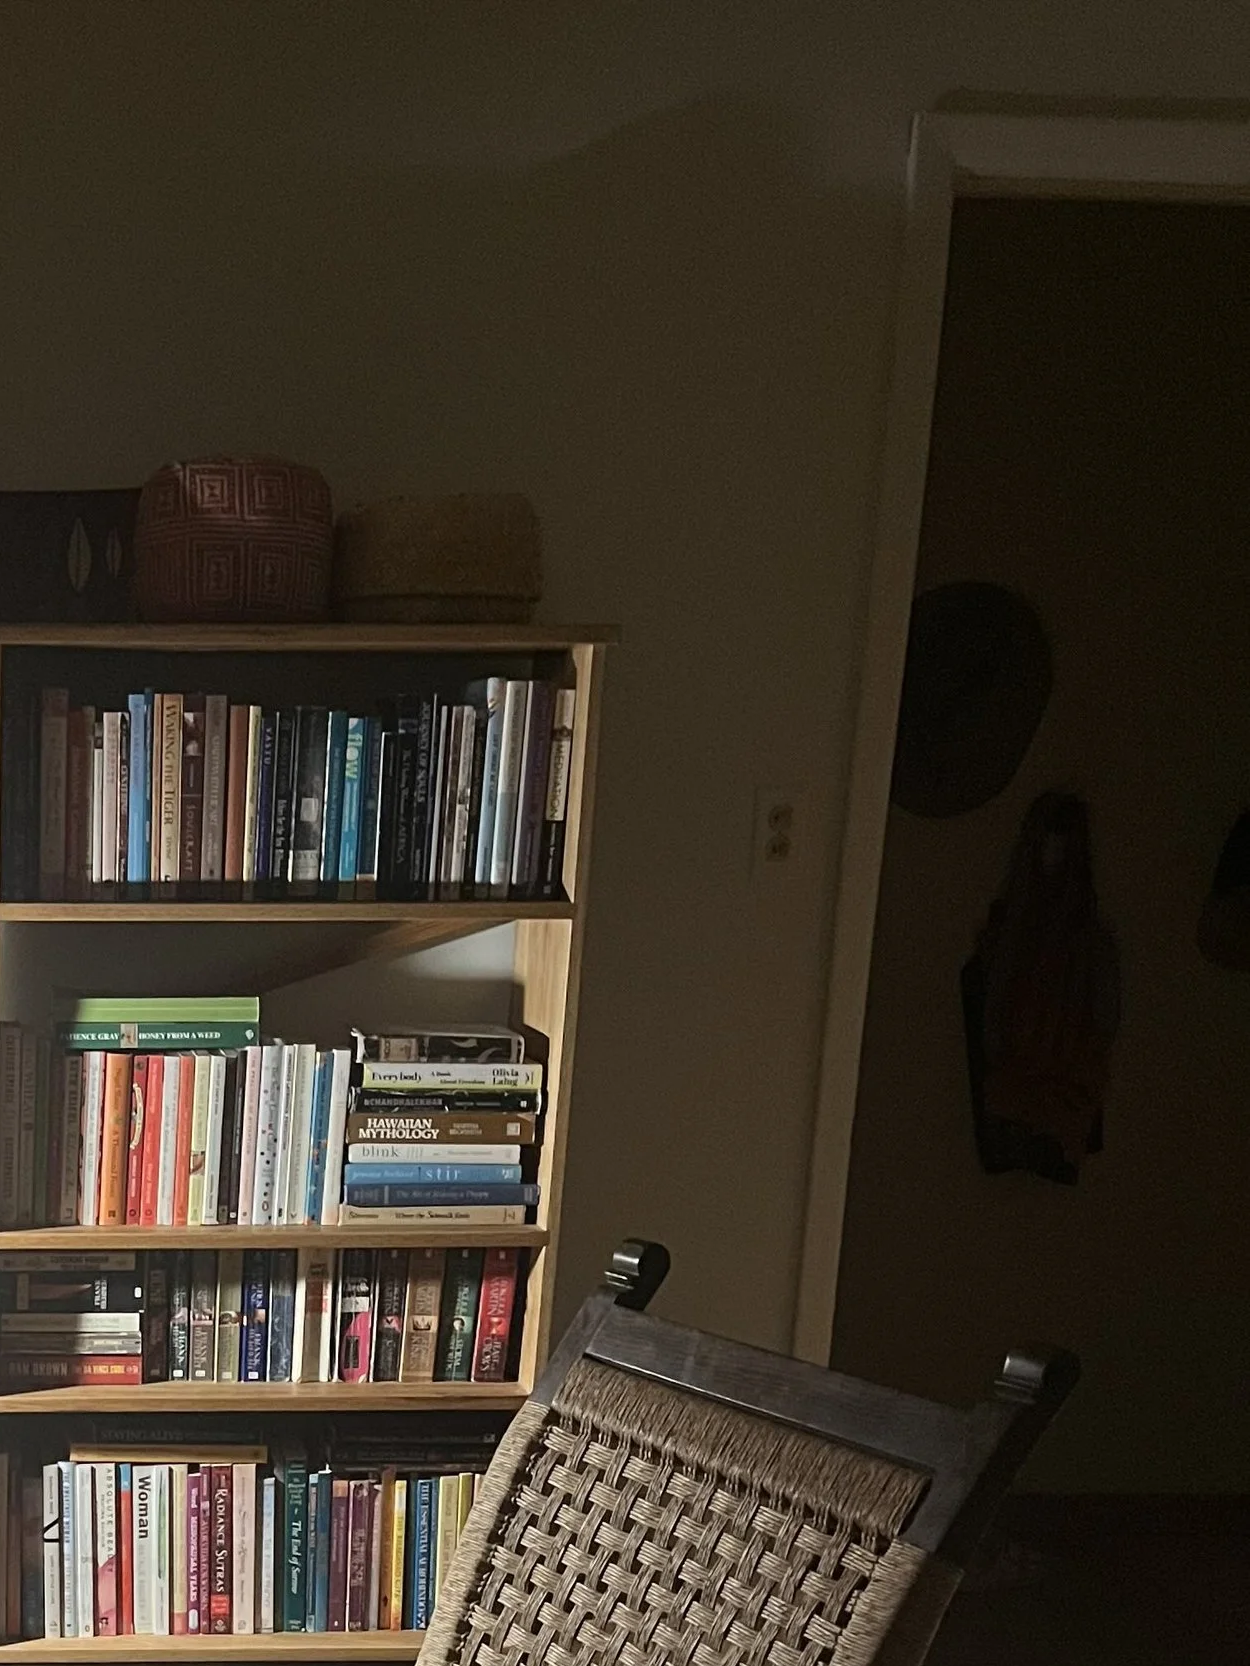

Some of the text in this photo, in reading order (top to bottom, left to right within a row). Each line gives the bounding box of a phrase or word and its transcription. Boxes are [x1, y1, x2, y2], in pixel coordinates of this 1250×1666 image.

[165, 704, 178, 760] WAKING
[346, 733, 363, 779] flow
[550, 744, 564, 818] MEDITATION
[164, 790, 176, 826] TIGER
[97, 1032, 119, 1040] GRAY
[139, 1031, 166, 1040] HONEY
[166, 1032, 190, 1040] FROM
[197, 1031, 221, 1040] WEED
[372, 1071, 423, 1083] Everybody
[492, 1068, 518, 1077] Olivia
[367, 1118, 432, 1128] HAWAIIAN
[358, 1129, 439, 1139] MYTHOLOGY
[362, 1145, 400, 1157] blink
[426, 1166, 461, 1180] stir
[32, 1362, 68, 1376] BROWN
[420, 1484, 429, 1503] THE
[138, 1475, 151, 1539] Woman
[292, 1520, 302, 1537] The
[419, 1504, 429, 1555] ESSENTIAL
[215, 1489, 228, 1592] RADIANCE SUTRAS
[291, 1538, 301, 1556] End
[290, 1556, 301, 1566] of
